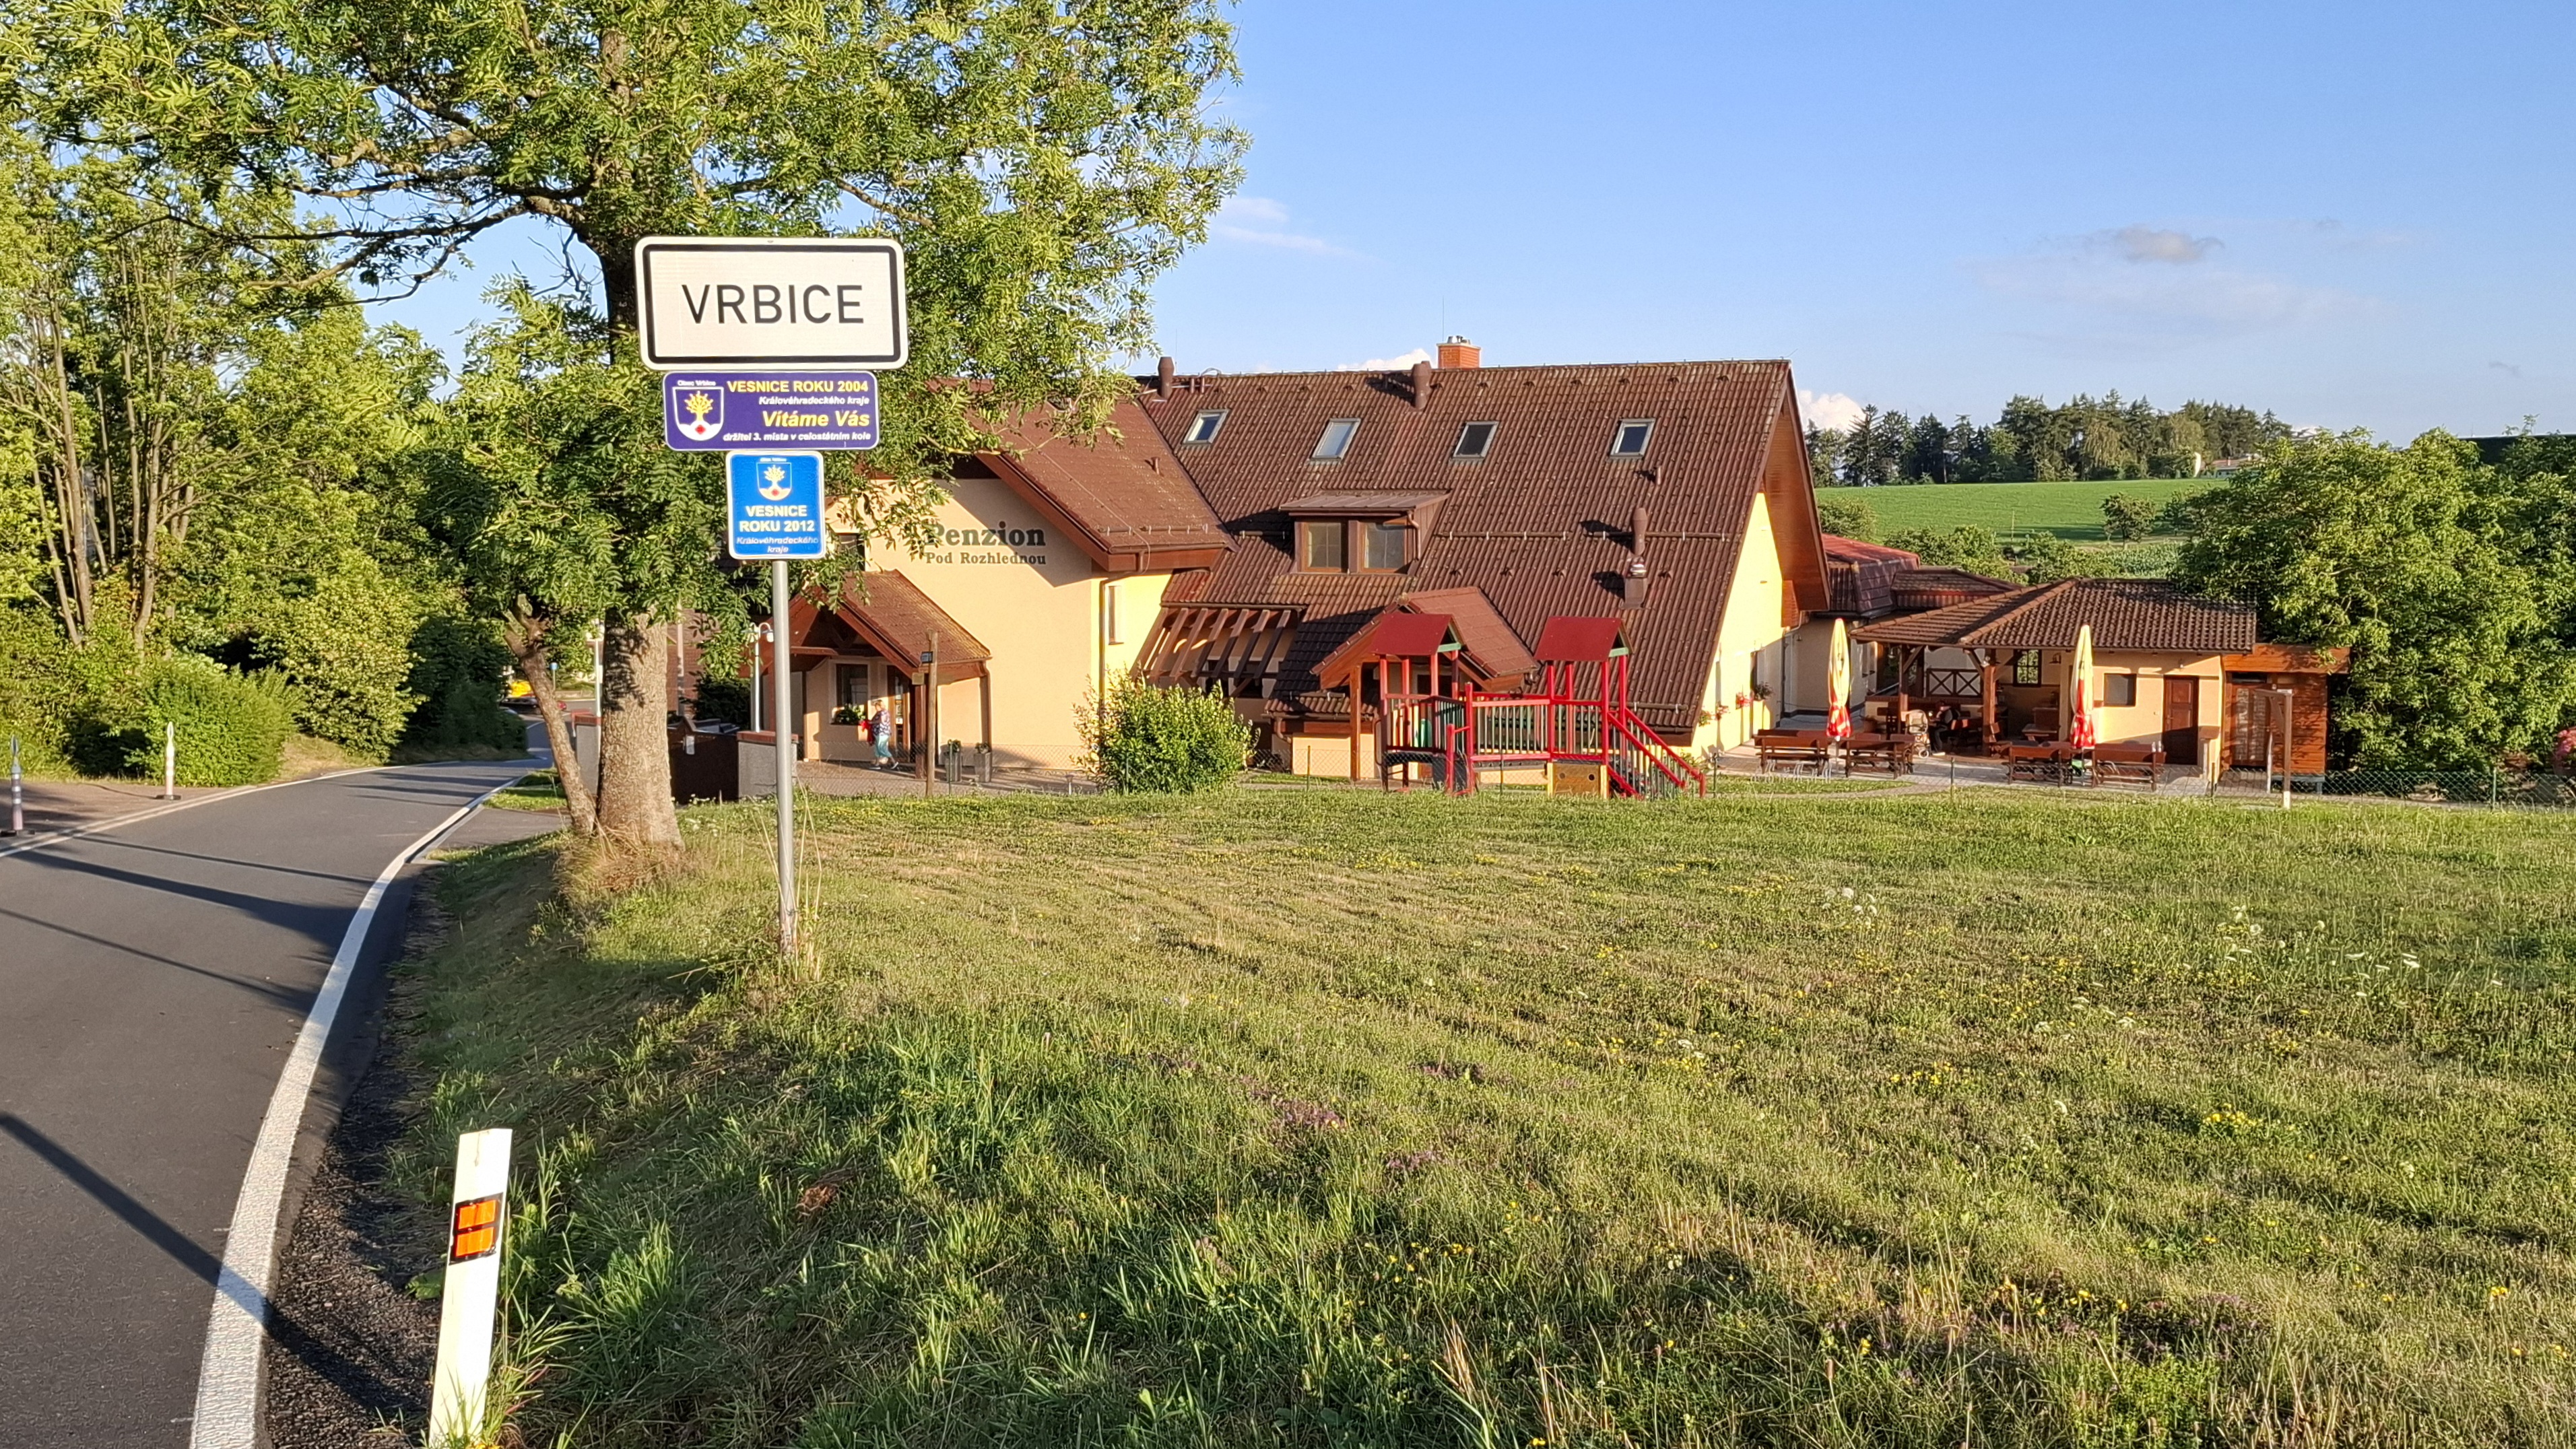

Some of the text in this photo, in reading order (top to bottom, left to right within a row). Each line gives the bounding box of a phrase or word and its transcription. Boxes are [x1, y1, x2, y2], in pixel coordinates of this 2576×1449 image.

[681, 284, 864, 324] VRBICE
[727, 380, 869, 393] VESNICE ROKU 2004
[759, 396, 869, 405] Královéhradeckého kraje
[762, 409, 870, 427] Vítáme Vás
[753, 433, 762, 441] 3.
[852, 432, 871, 440] kole
[746, 505, 807, 517] VESNICE
[739, 520, 815, 532] ROKU 2012
[925, 520, 1047, 546] Penzion
[925, 552, 1047, 565] Pod Rozhlednou
